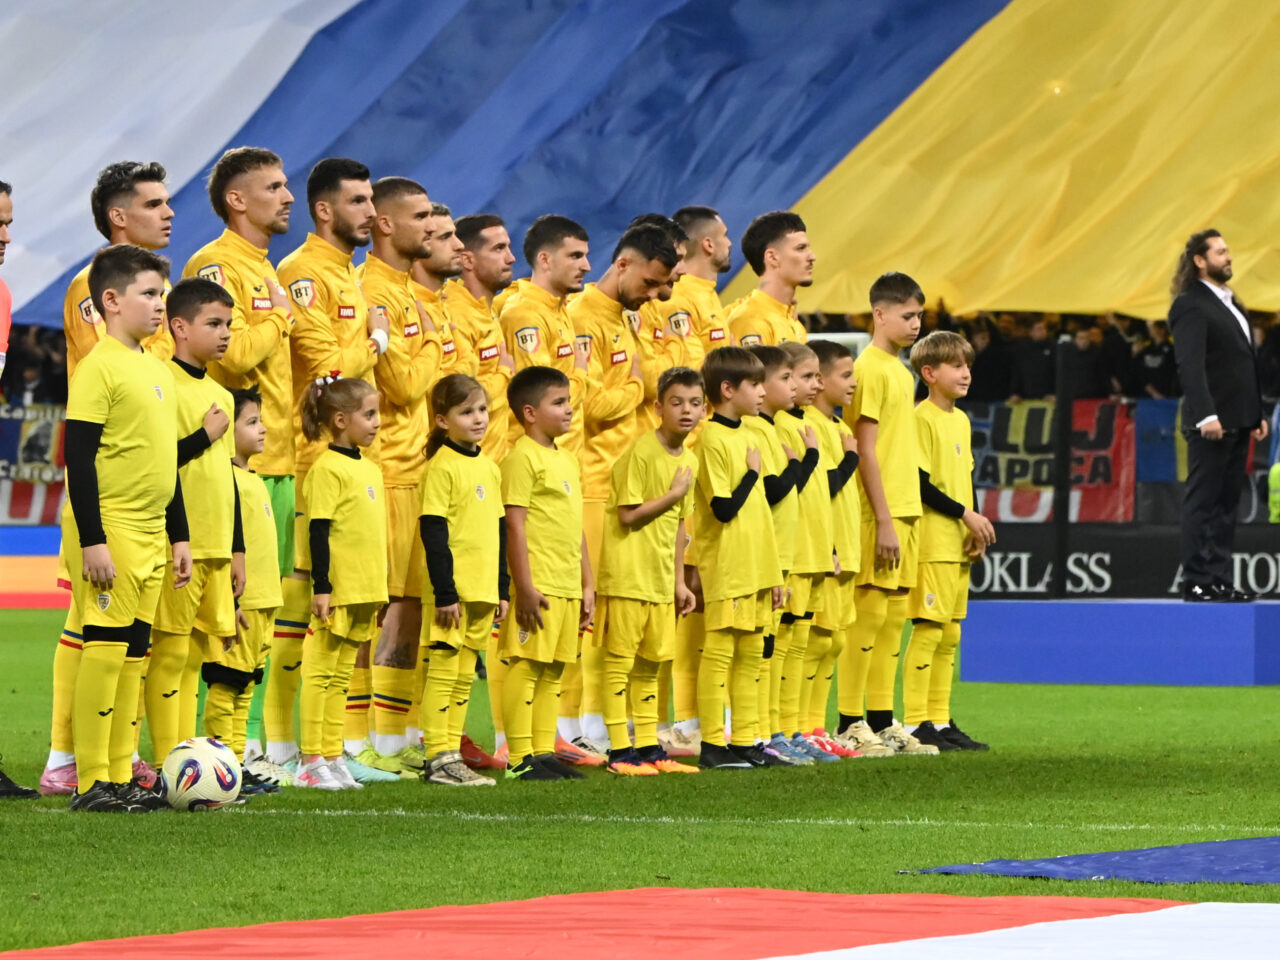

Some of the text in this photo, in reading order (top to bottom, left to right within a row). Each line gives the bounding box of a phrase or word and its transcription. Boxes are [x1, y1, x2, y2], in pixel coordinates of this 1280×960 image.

[294, 286, 310, 299] BT
[673, 318, 686, 330] BT
[520, 333, 535, 345] BT
